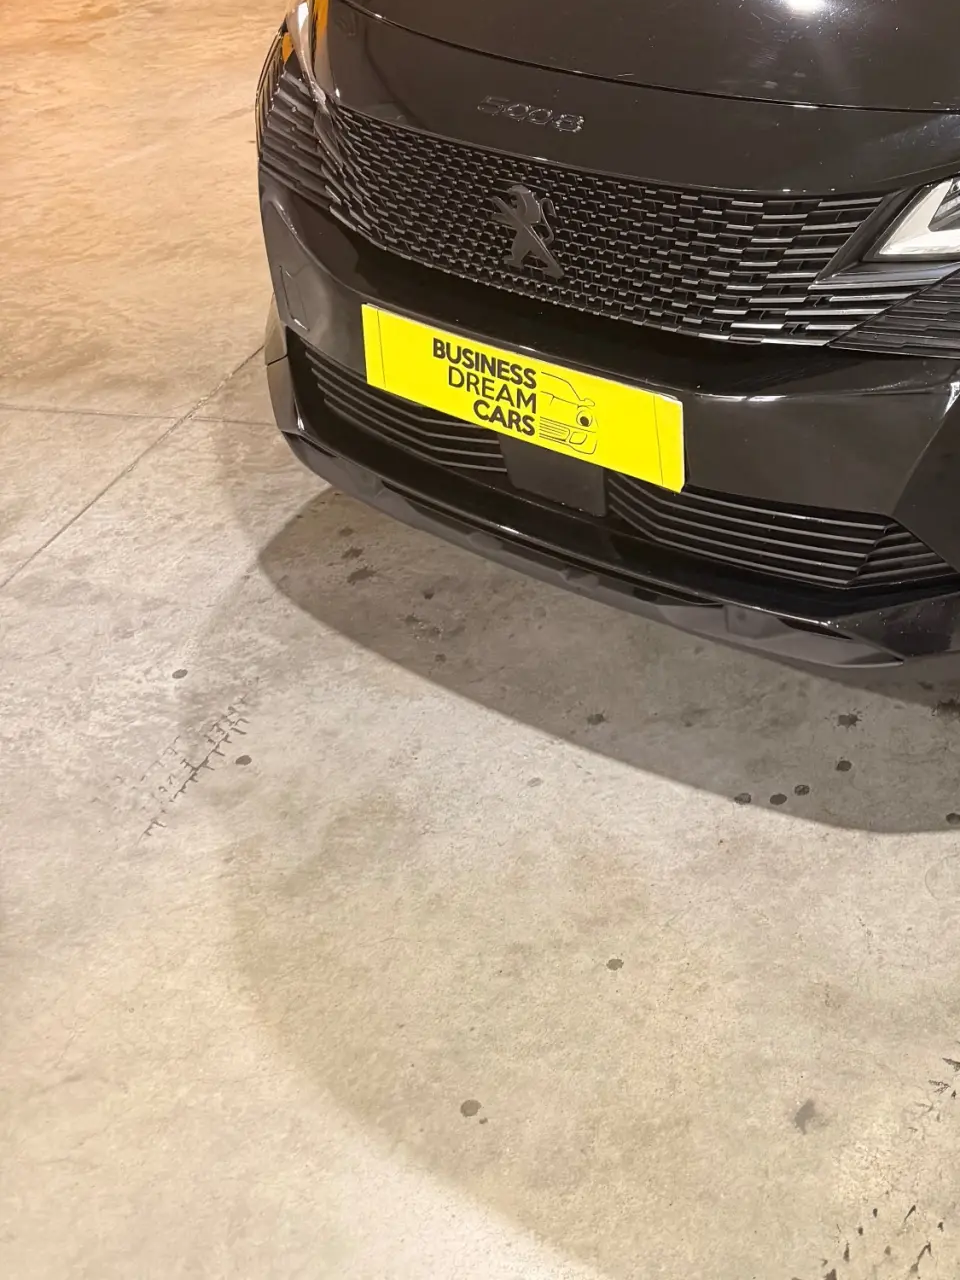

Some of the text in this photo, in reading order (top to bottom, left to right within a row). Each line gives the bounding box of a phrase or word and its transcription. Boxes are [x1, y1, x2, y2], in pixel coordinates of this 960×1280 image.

[477, 94, 585, 133] 5008
[432, 337, 537, 389] BUSINESS
[448, 365, 537, 414] DREAM
[473, 399, 536, 436] CARS
